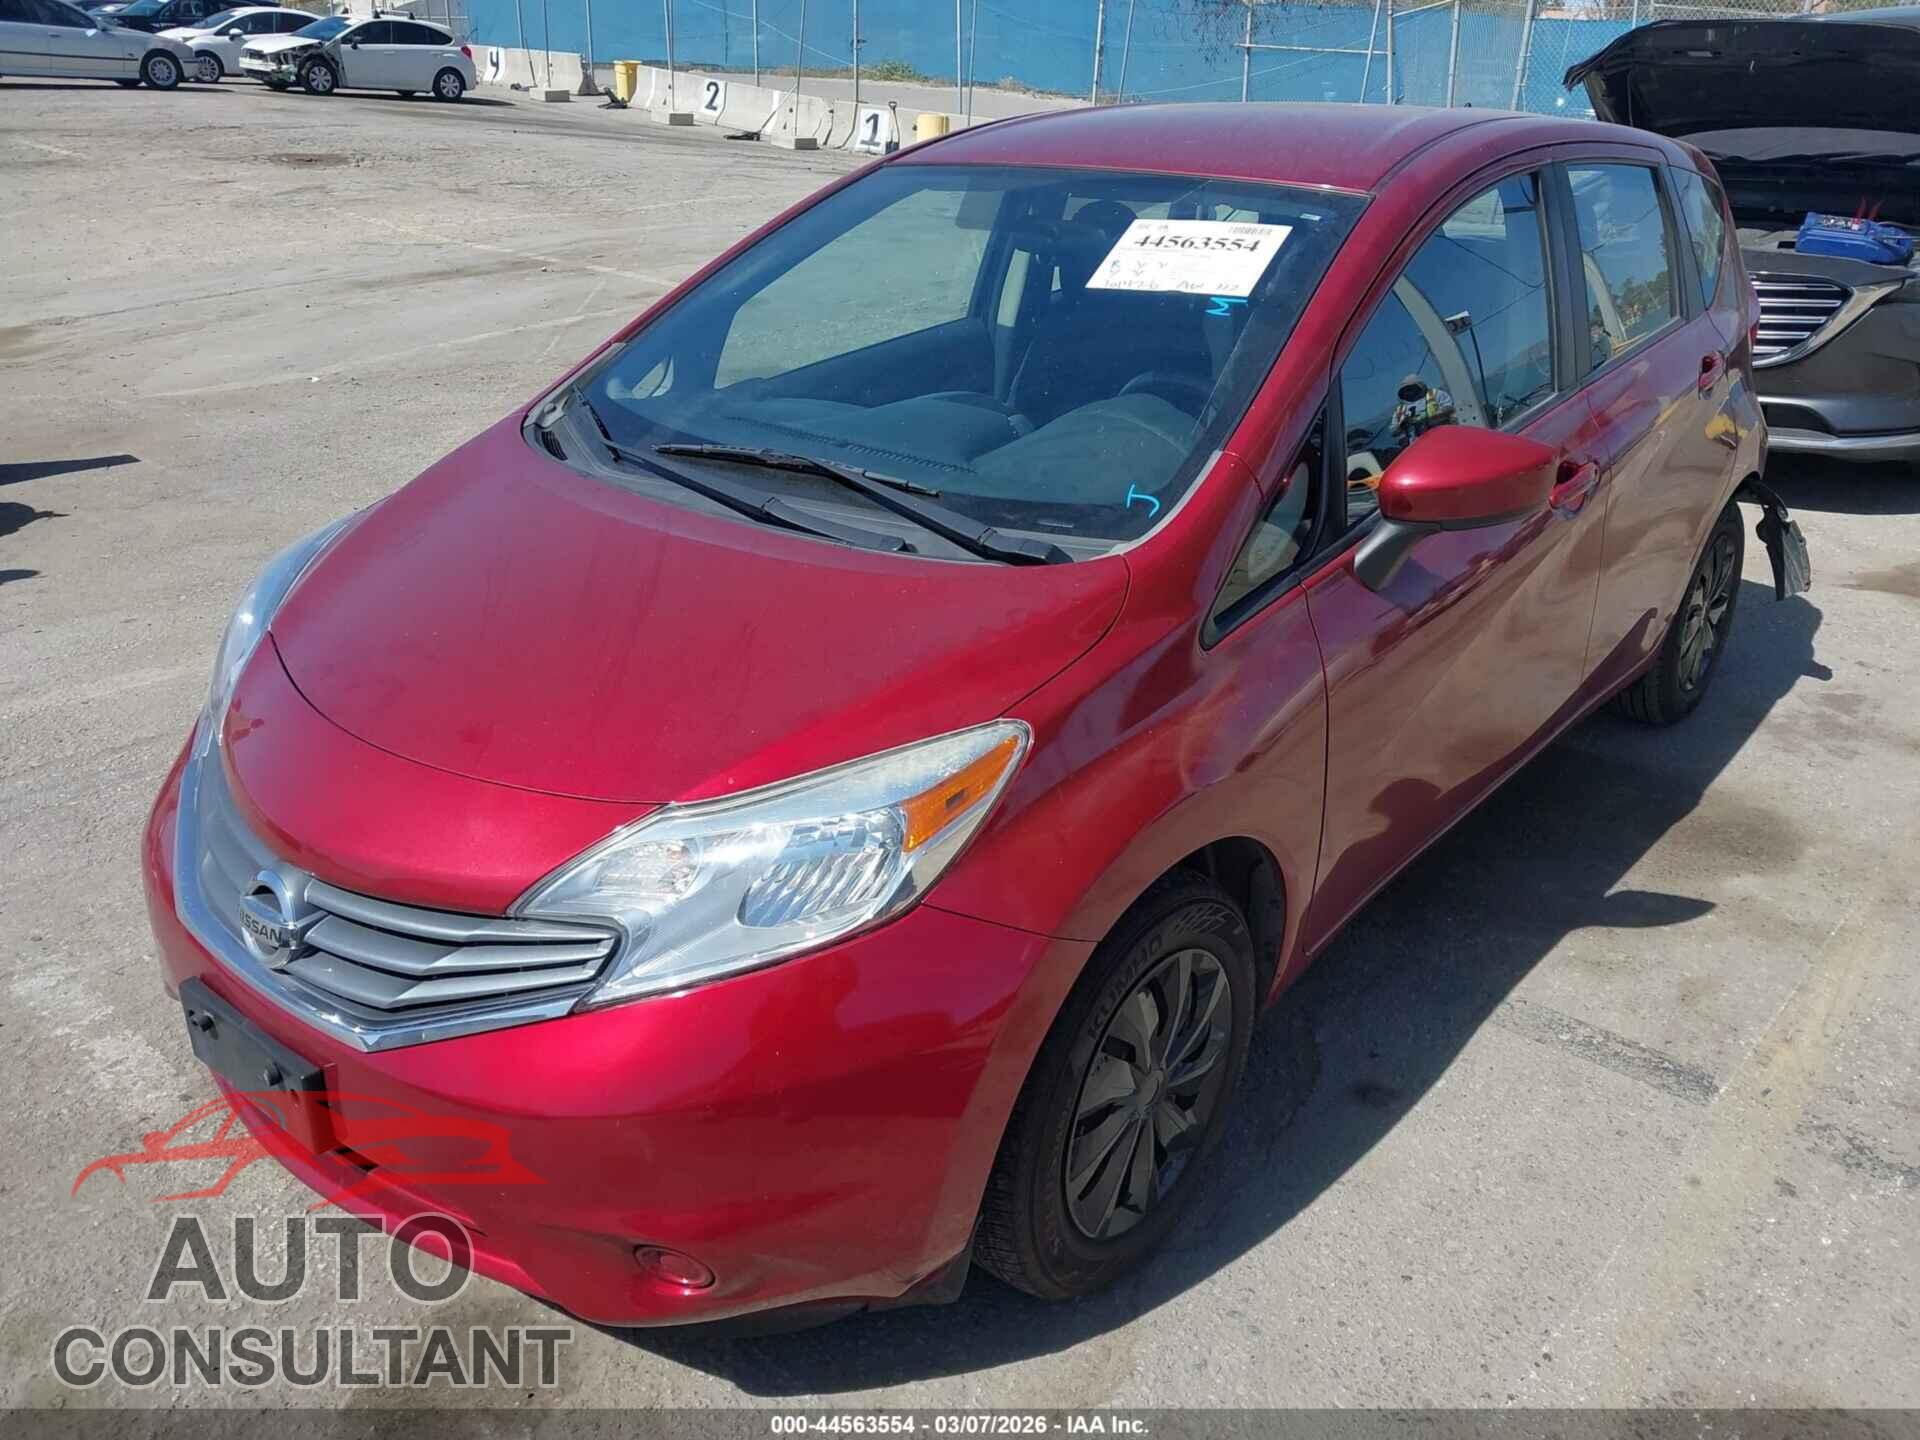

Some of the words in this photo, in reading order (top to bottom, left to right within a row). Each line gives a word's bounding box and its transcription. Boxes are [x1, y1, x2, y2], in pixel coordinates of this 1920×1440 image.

[490, 48, 499, 79] 4
[705, 81, 719, 110] 2
[860, 113, 880, 146] 1
[1134, 235, 1261, 252] 44563554
